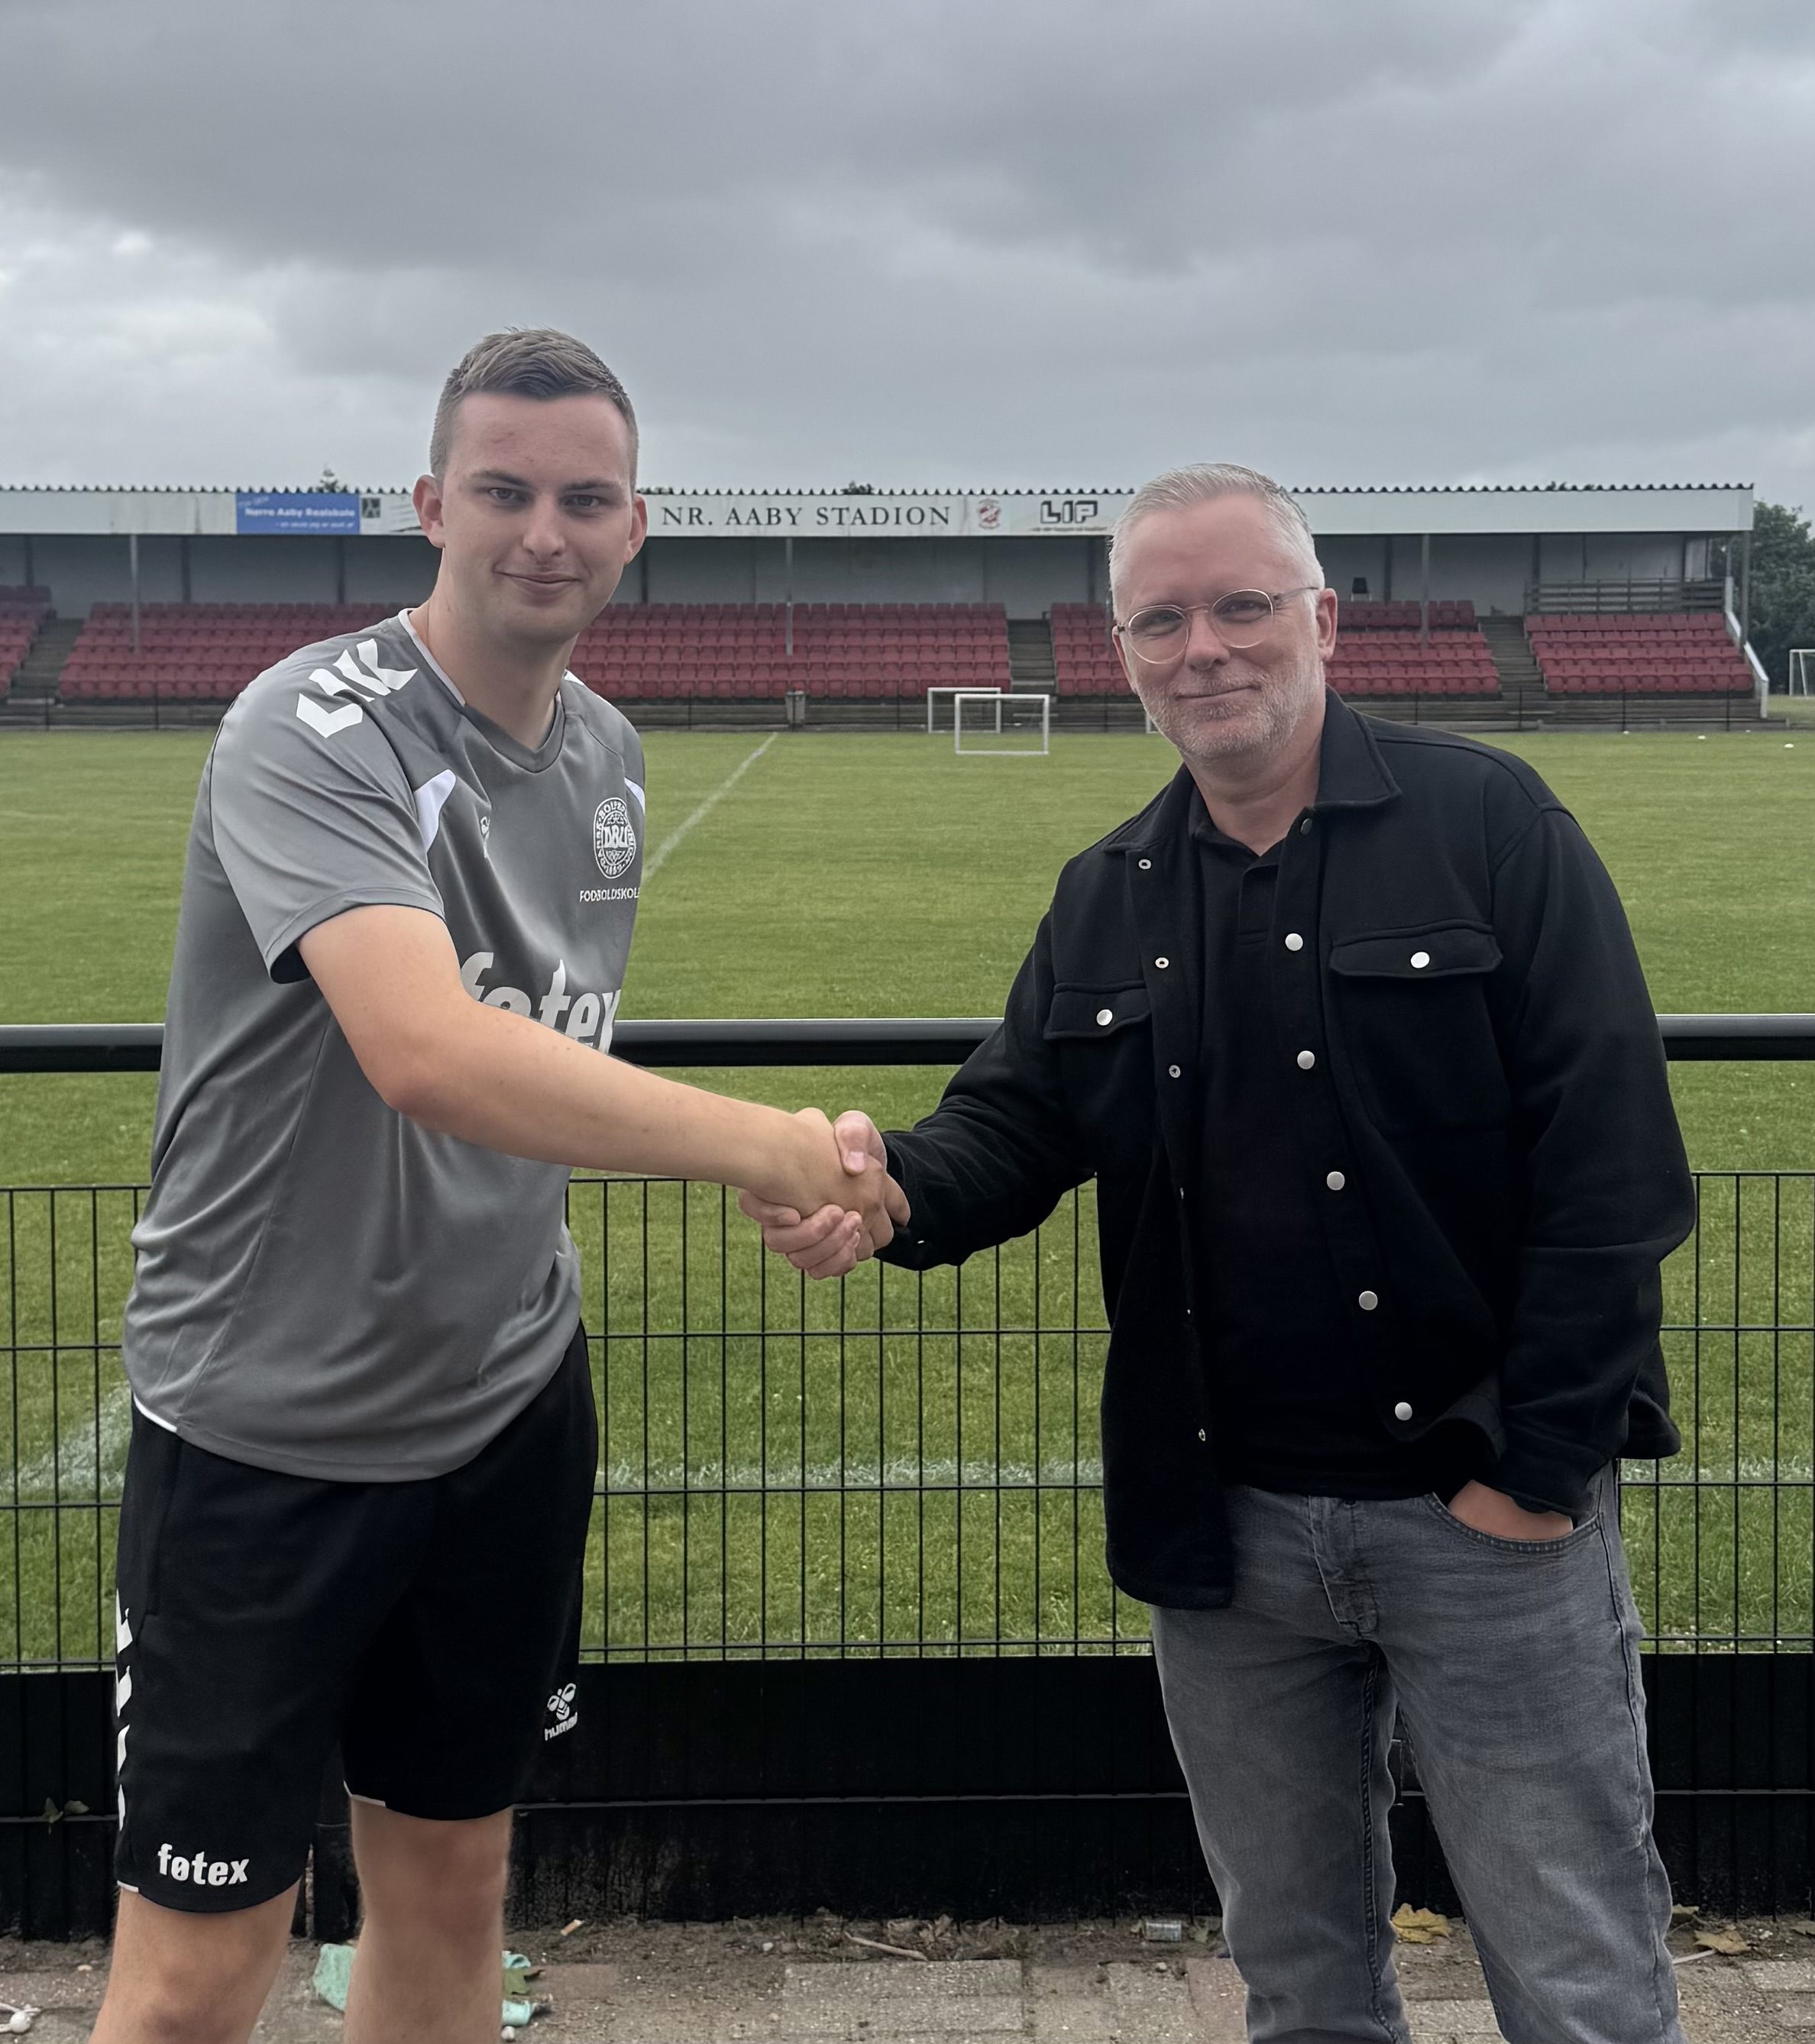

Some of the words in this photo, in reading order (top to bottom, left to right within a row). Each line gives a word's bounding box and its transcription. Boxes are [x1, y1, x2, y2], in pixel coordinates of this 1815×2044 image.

[661, 506, 713, 526] NR.
[725, 506, 803, 526] AABY
[816, 506, 950, 526] STADION
[1040, 500, 1098, 524] LIP
[157, 1842, 250, 1887] føtex
